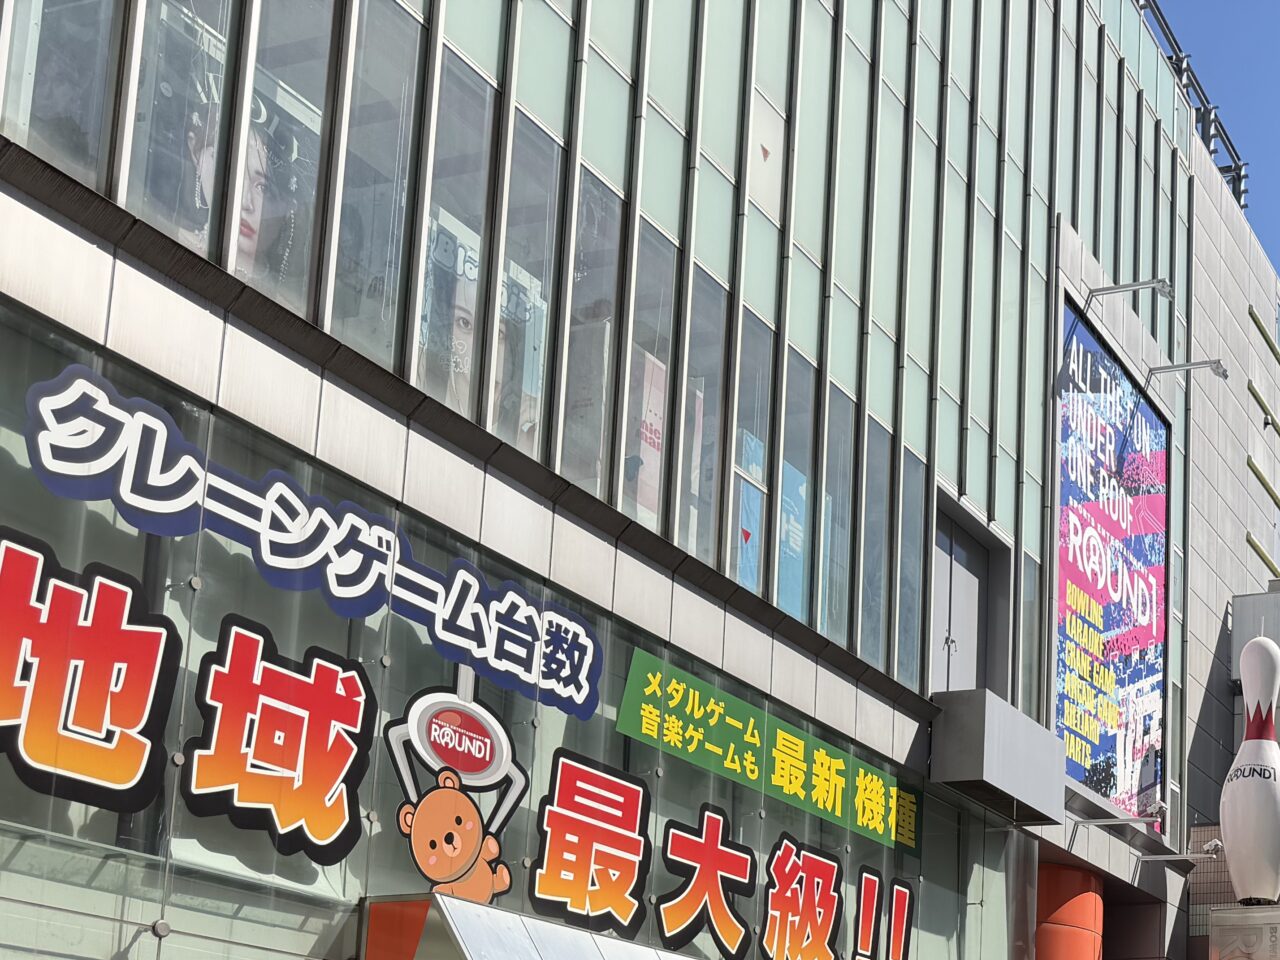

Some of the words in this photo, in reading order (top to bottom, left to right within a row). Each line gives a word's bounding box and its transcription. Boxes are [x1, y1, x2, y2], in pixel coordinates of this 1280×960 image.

[1069, 334, 1094, 395] ALL
[1099, 366, 1123, 432] THE
[1069, 383, 1117, 473] UNDER
[1068, 435, 1095, 501] ONE
[1099, 471, 1133, 535] ROOF
[39, 379, 594, 703] クレーンゲーム台数
[1068, 509, 1157, 636] ROUND1
[1066, 579, 1104, 631] BOWLING
[1066, 609, 1104, 659] KARAOKE
[0, 540, 365, 845] 地域
[1065, 640, 1092, 683] CRANE
[1065, 671, 1096, 713] ARCADE
[431, 724, 491, 761] ROUND1
[640, 706, 760, 780] 音楽ゲームも
[644, 671, 762, 746] メダルゲーム
[1065, 730, 1091, 770] DARTS
[771, 728, 918, 849] 最新機種
